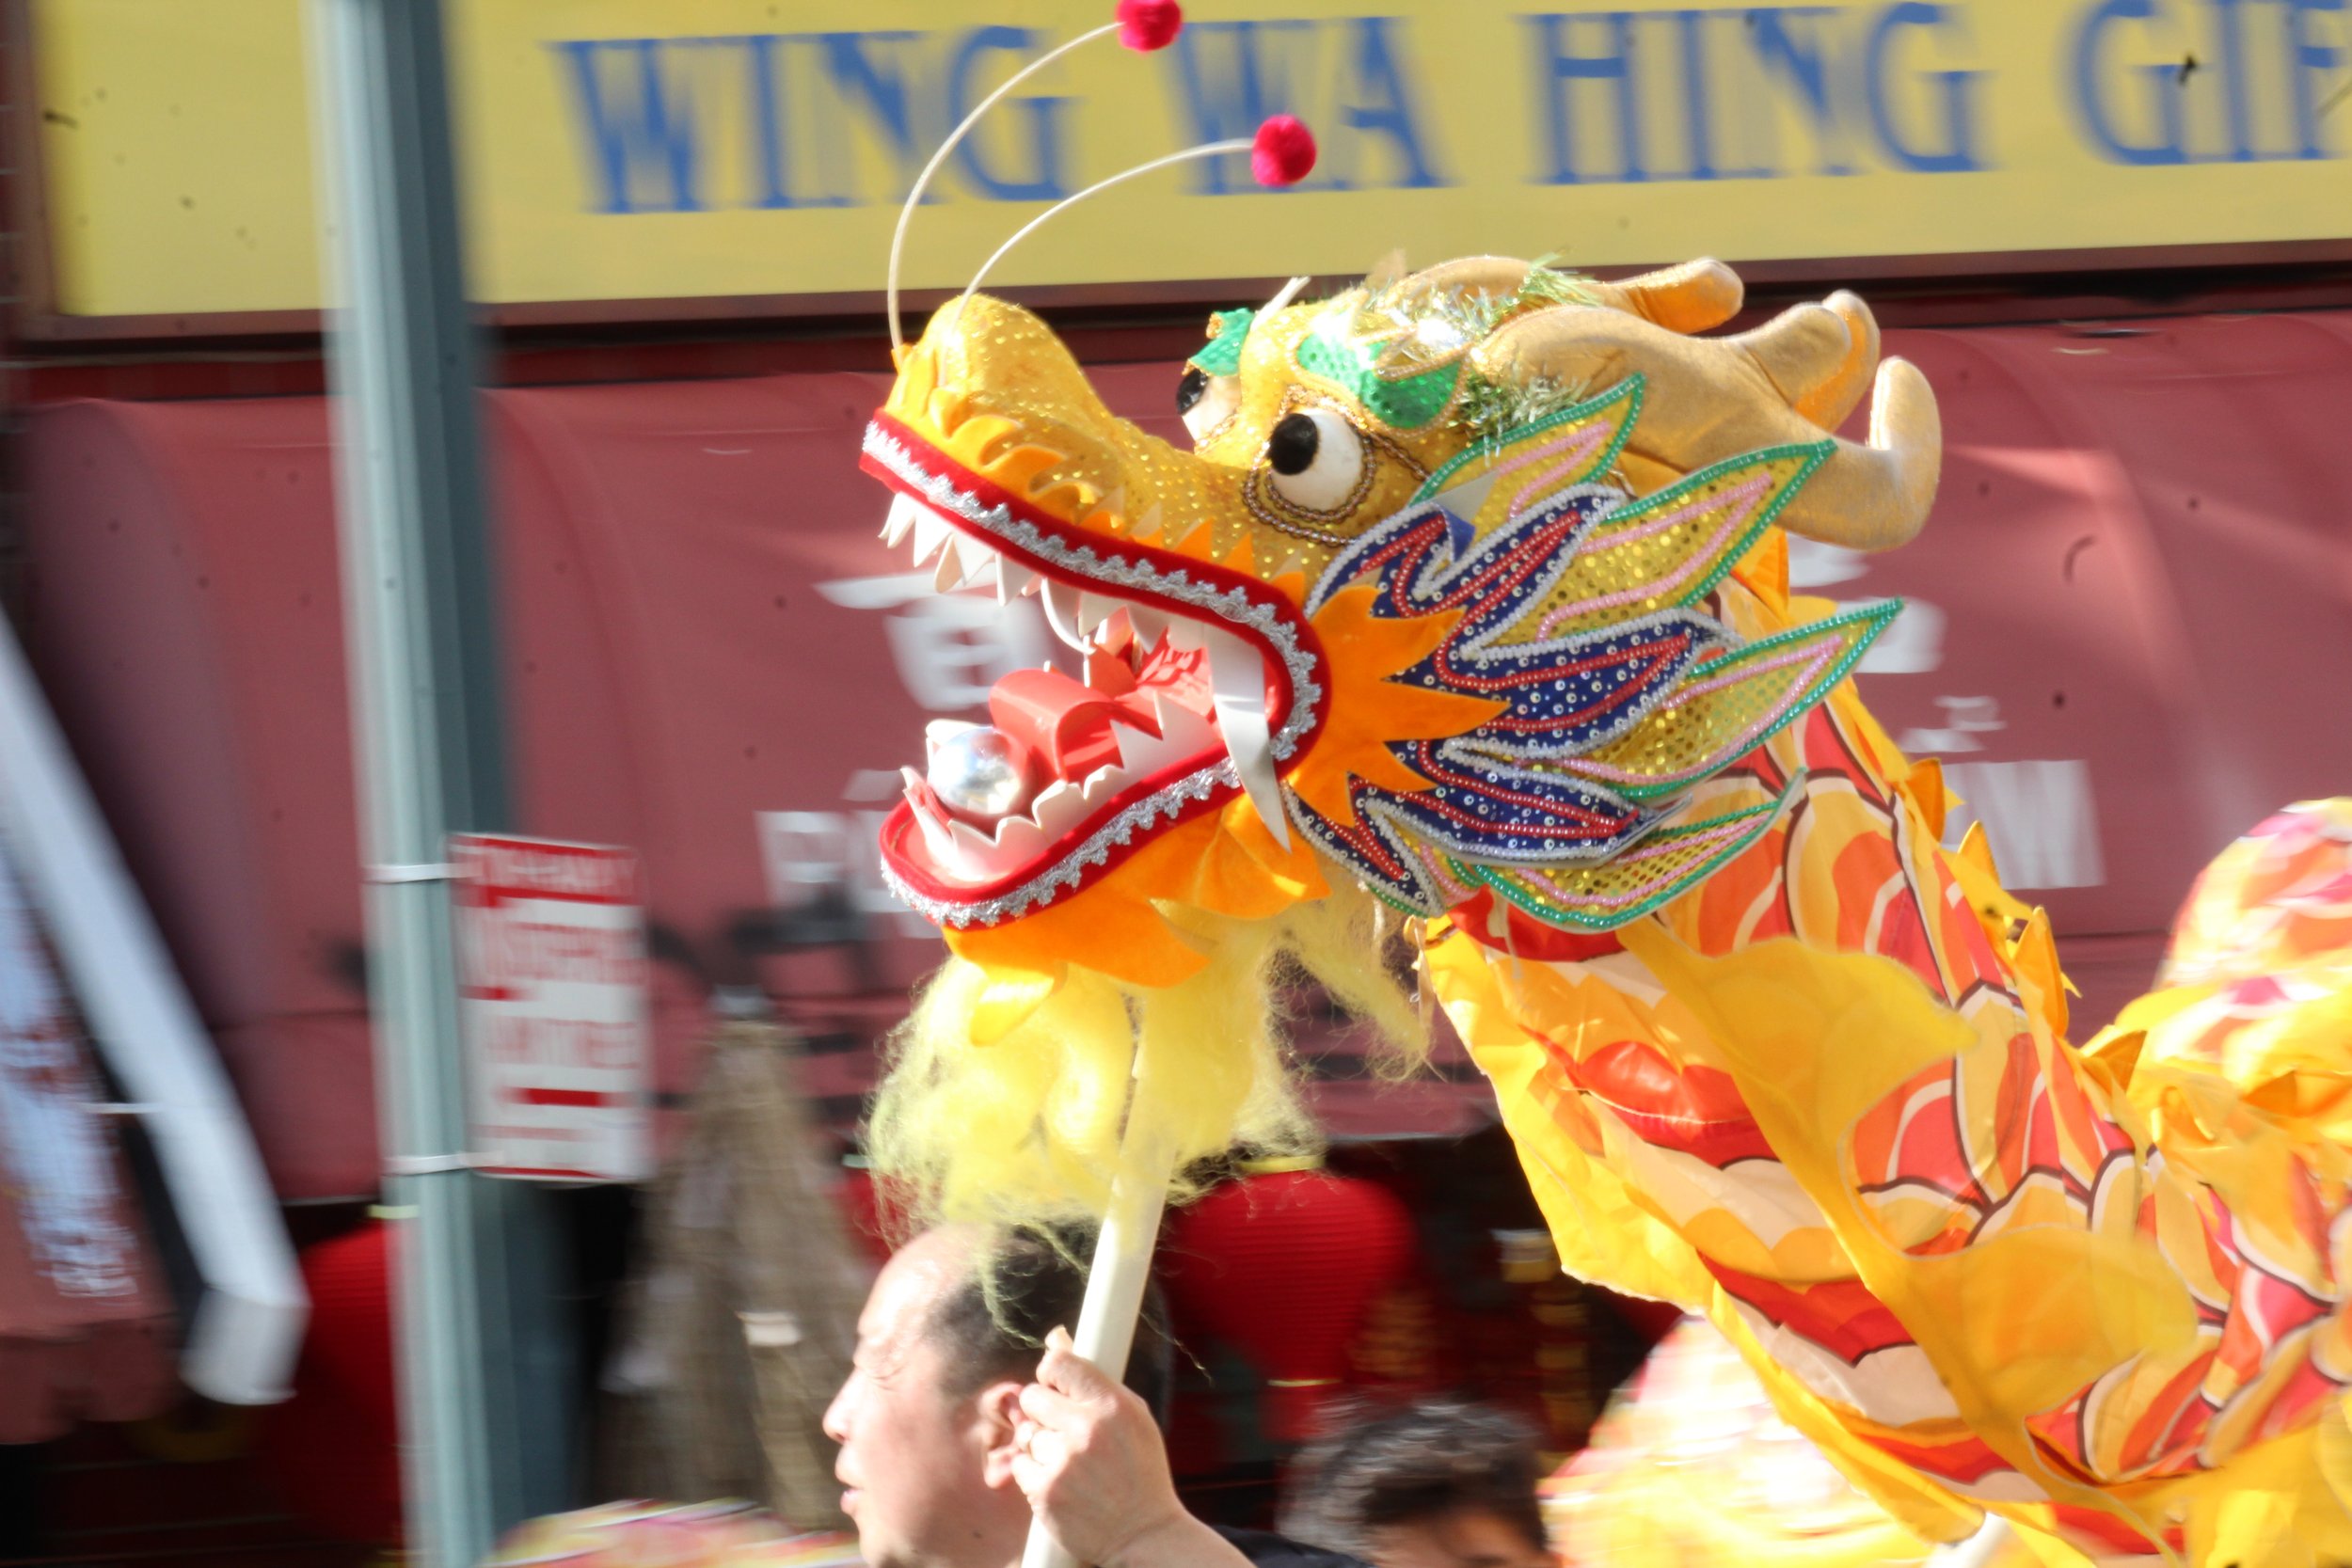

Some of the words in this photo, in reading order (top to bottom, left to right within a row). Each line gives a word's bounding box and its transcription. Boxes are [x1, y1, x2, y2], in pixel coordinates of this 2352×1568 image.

[543, 24, 1091, 214] WING
[1159, 16, 1460, 196] WA
[1511, 2, 1998, 185] HING
